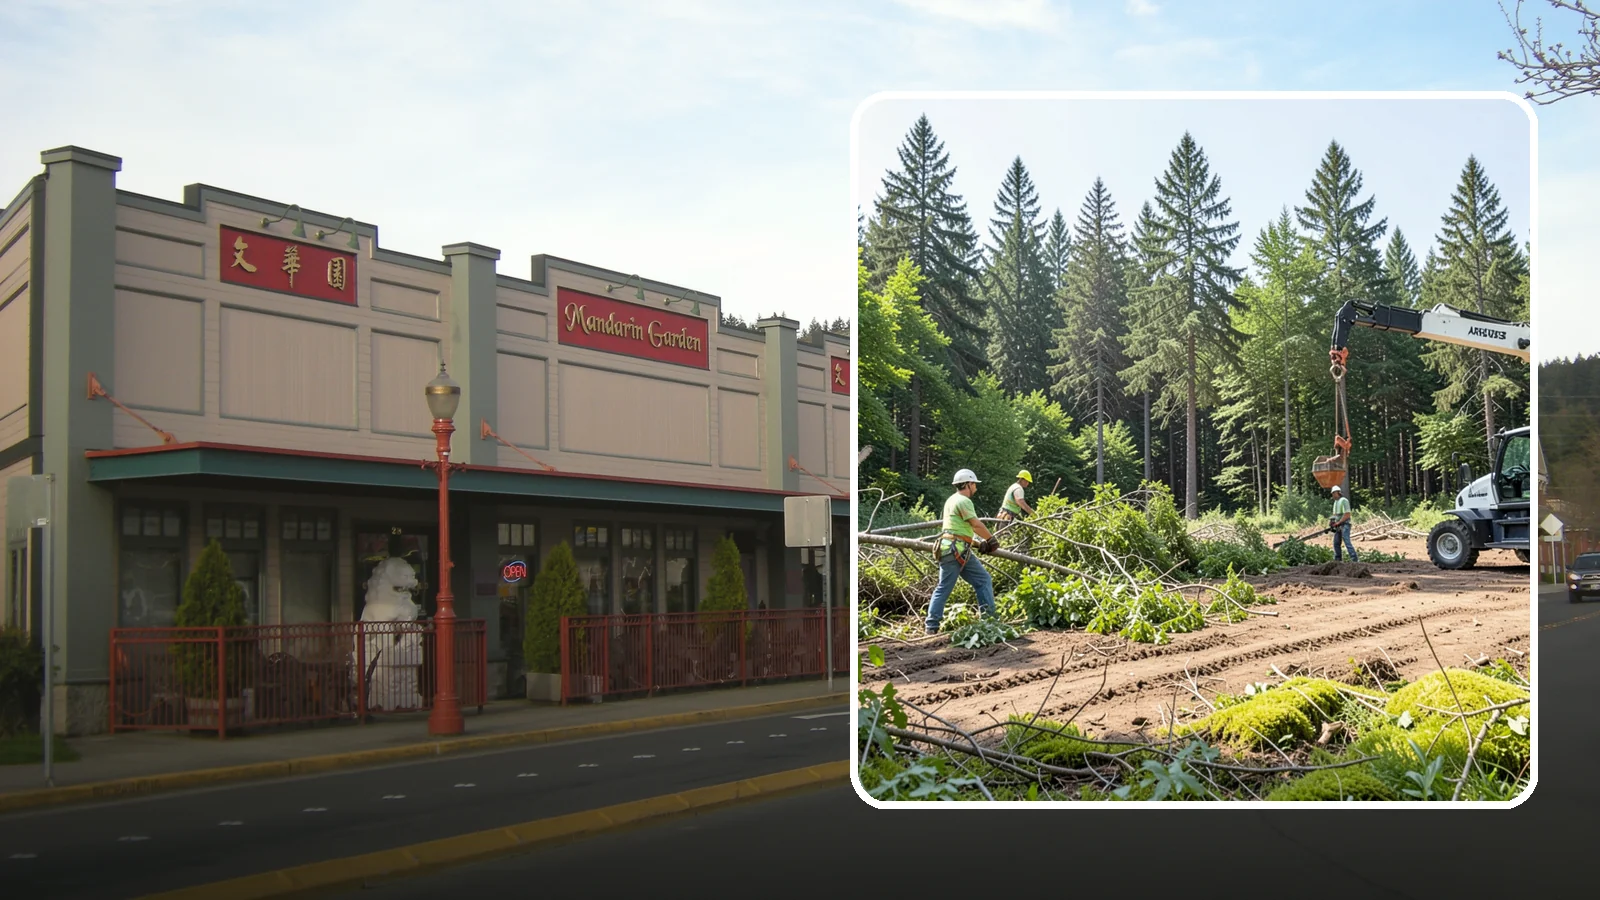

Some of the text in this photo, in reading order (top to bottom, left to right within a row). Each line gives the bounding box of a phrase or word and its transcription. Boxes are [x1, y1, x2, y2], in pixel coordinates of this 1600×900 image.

[230, 235, 346, 291] 文華園
[564, 302, 702, 352] Mandarin Garden
[503, 565, 527, 578] OPEN
